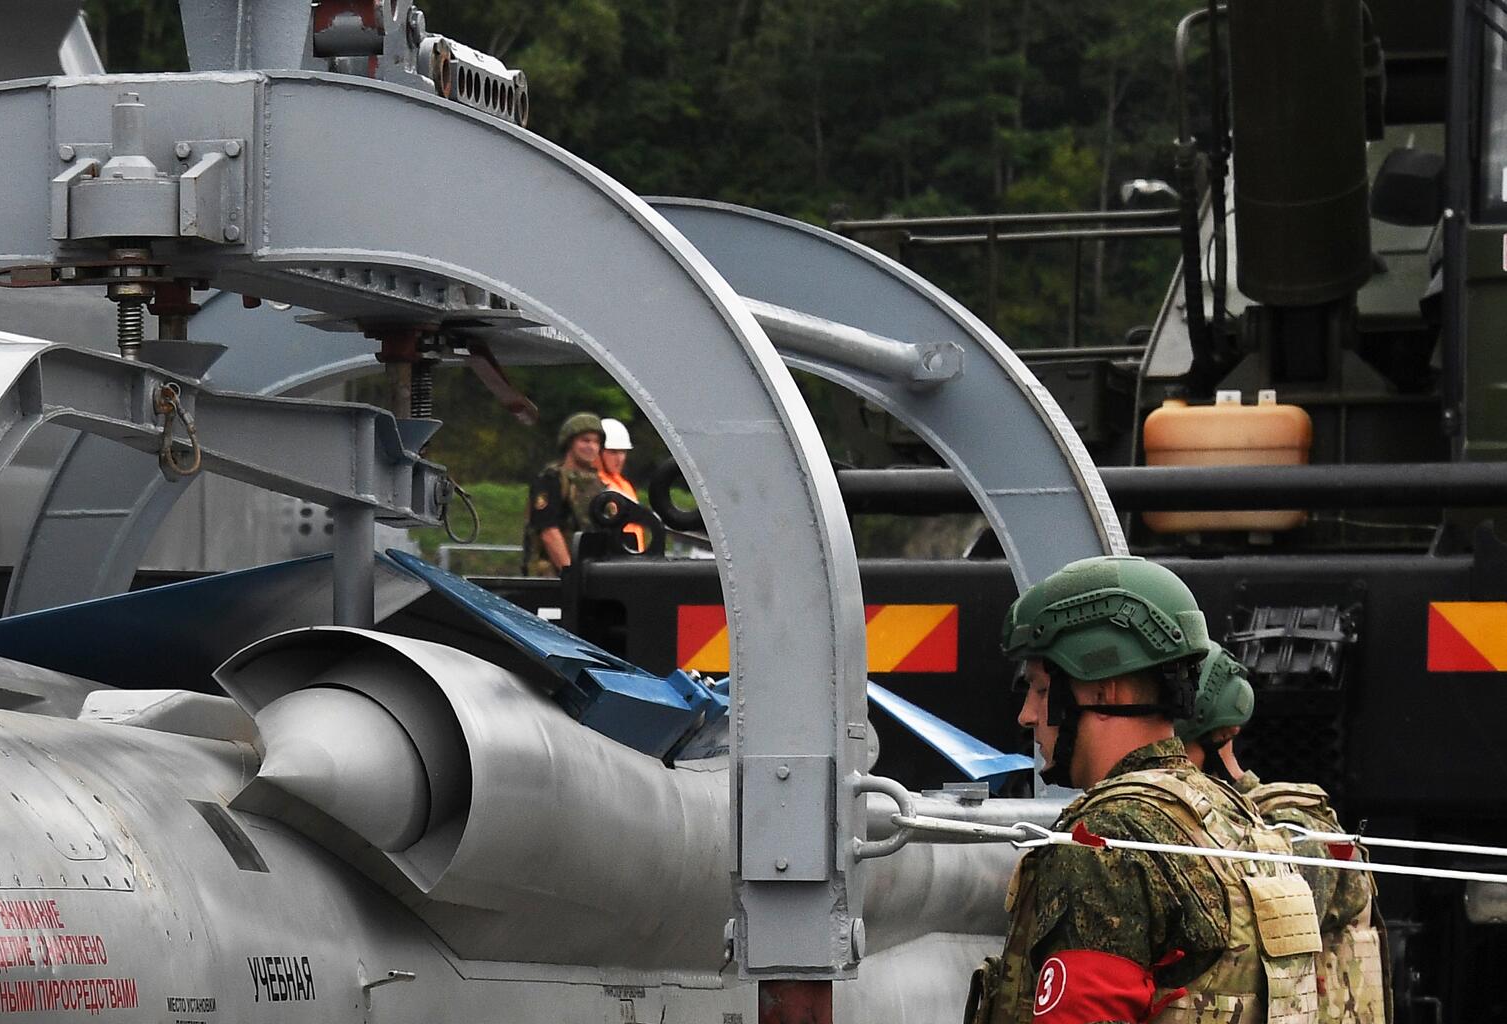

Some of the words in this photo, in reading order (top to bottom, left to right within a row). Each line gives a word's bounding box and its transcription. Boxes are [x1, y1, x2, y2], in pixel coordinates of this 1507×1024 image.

[36, 935, 108, 966] СНАРЯЖЕНО
[37, 978, 138, 1015] ПИРОСРЕДСТВАМИ
[247, 956, 316, 1002] УЧЕБНАЯ
[1038, 967, 1055, 1006] 3
[167, 997, 186, 1012] МЕСТО
